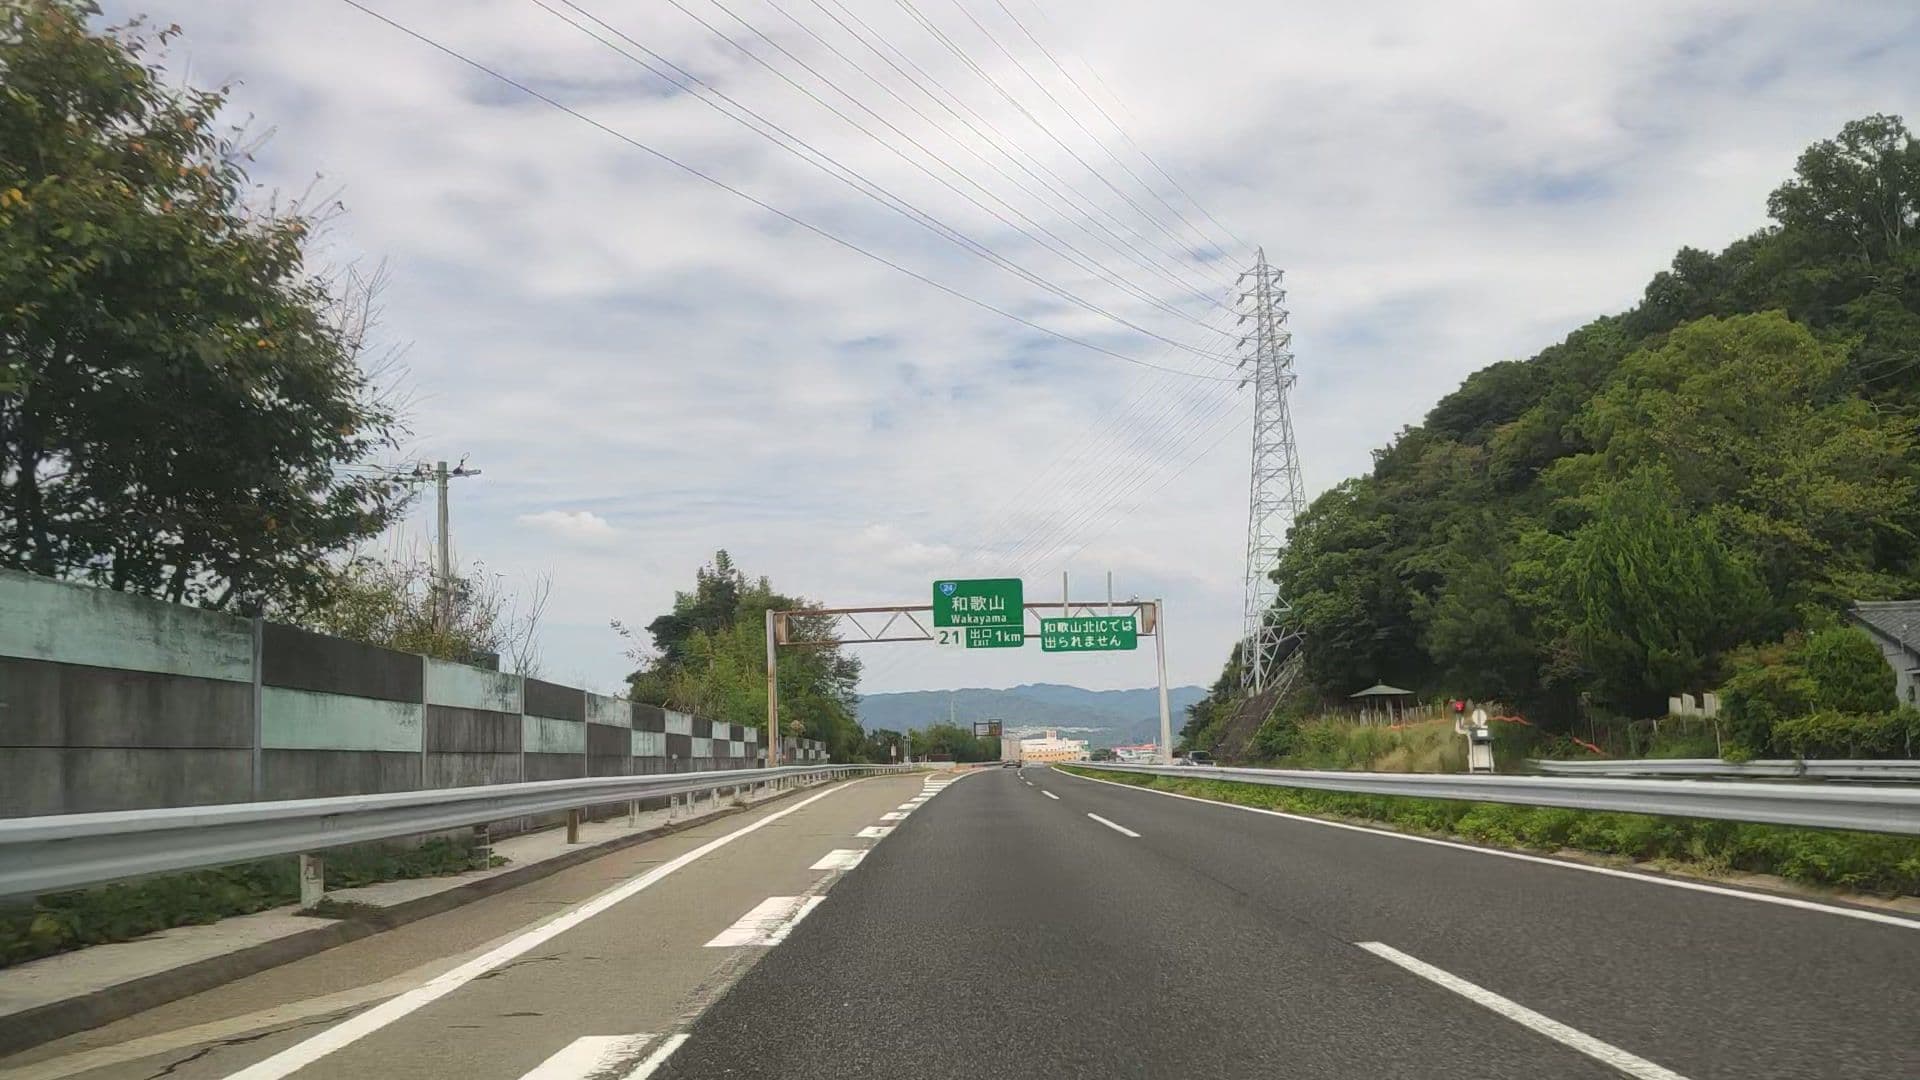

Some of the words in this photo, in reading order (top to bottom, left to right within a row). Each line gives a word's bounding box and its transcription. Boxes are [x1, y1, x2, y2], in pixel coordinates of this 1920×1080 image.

[951, 595, 1005, 612] 和歌山
[951, 614, 1007, 625] Wakayama
[939, 630, 960, 645] 21
[970, 628, 992, 640] 出口
[995, 630, 1021, 643] 1km
[973, 639, 989, 647] EXIT
[1045, 634, 1121, 649] 出られません
